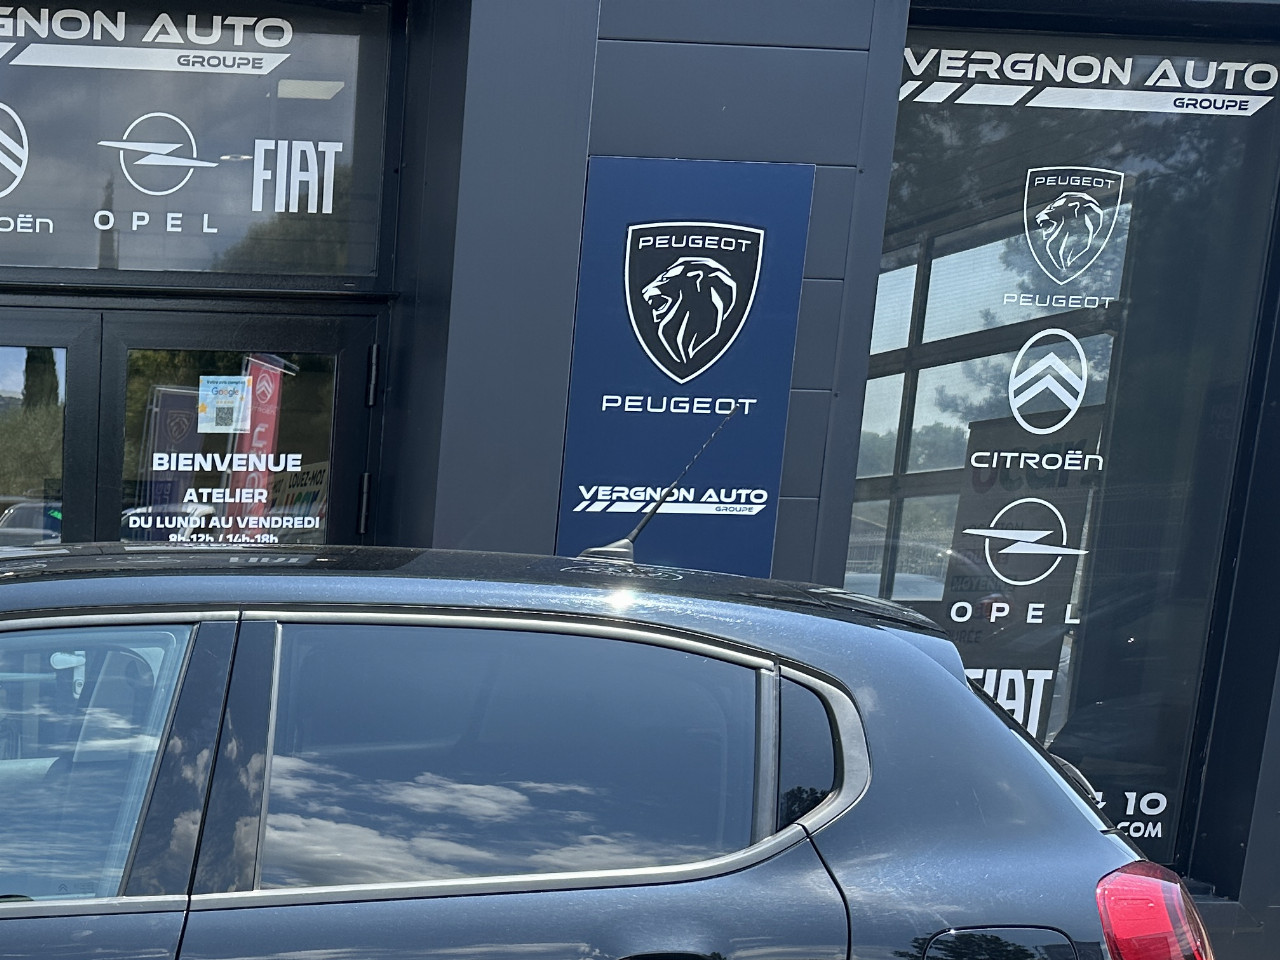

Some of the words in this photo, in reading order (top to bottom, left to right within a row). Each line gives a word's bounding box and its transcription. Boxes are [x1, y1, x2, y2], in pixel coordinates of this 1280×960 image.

[142, 13, 293, 48] AUTO
[177, 54, 264, 70] GROUPE
[904, 47, 1133, 86] VERGNON
[1144, 59, 1279, 92] AUTO
[1173, 97, 1250, 112] GROUPE
[252, 139, 343, 214] FIAT
[1034, 174, 1116, 190] PEUGEOT
[93, 210, 218, 234] OPEL
[638, 234, 751, 253] PEUGEOT
[1002, 293, 1115, 310] PEUGEOT
[211, 386, 240, 398] Google
[602, 394, 757, 416] PEUGEOT
[152, 452, 302, 472] BIENVENUE
[183, 488, 268, 503] ATELIER
[578, 485, 695, 502] VERGNON
[700, 488, 768, 504] AUTO
[128, 516, 153, 528] DU
[156, 516, 206, 529] LUNDI
[209, 516, 233, 529] AU
[236, 516, 320, 529] VENDREDI
[950, 601, 1081, 625] OPEL
[1124, 791, 1168, 815] 10
